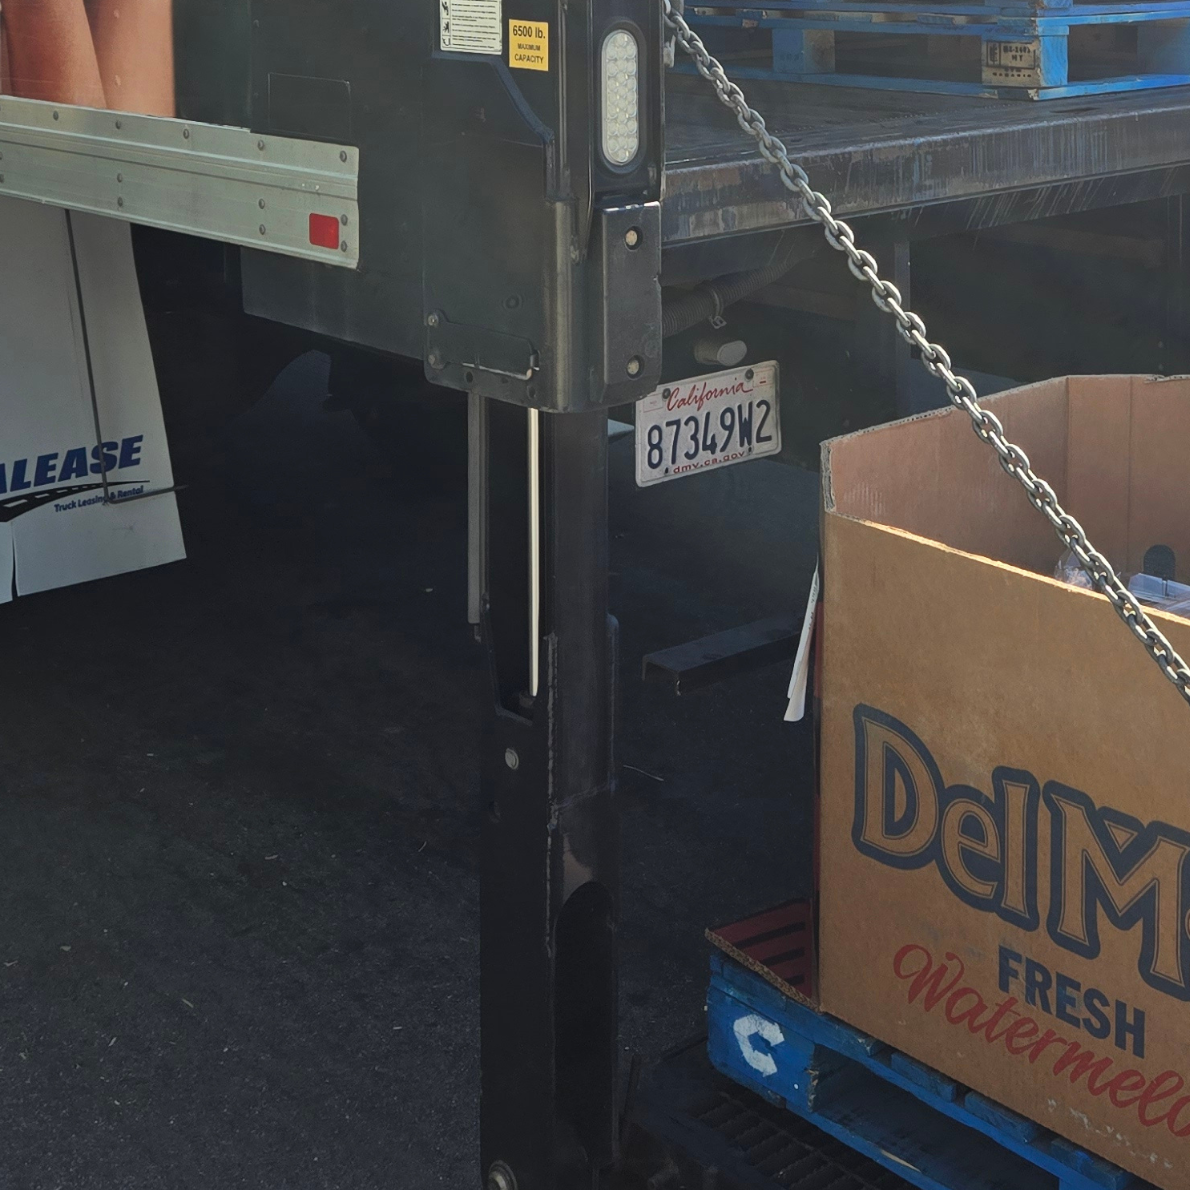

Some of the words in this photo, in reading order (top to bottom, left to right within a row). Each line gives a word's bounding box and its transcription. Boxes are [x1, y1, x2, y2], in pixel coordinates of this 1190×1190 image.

[512, 25, 532, 38] 6500
[534, 27, 546, 39] lb.
[514, 53, 544, 64] CAPACITY
[517, 42, 541, 51] MAXIMUM
[665, 378, 754, 412] California
[646, 398, 773, 470] 87349W2
[672, 451, 746, 474] dmv.ca.gov
[54, 500, 77, 513] Truck
[110, 491, 116, 500] &
[117, 485, 144, 498] Rental
[998, 945, 1146, 1059] FRESH
